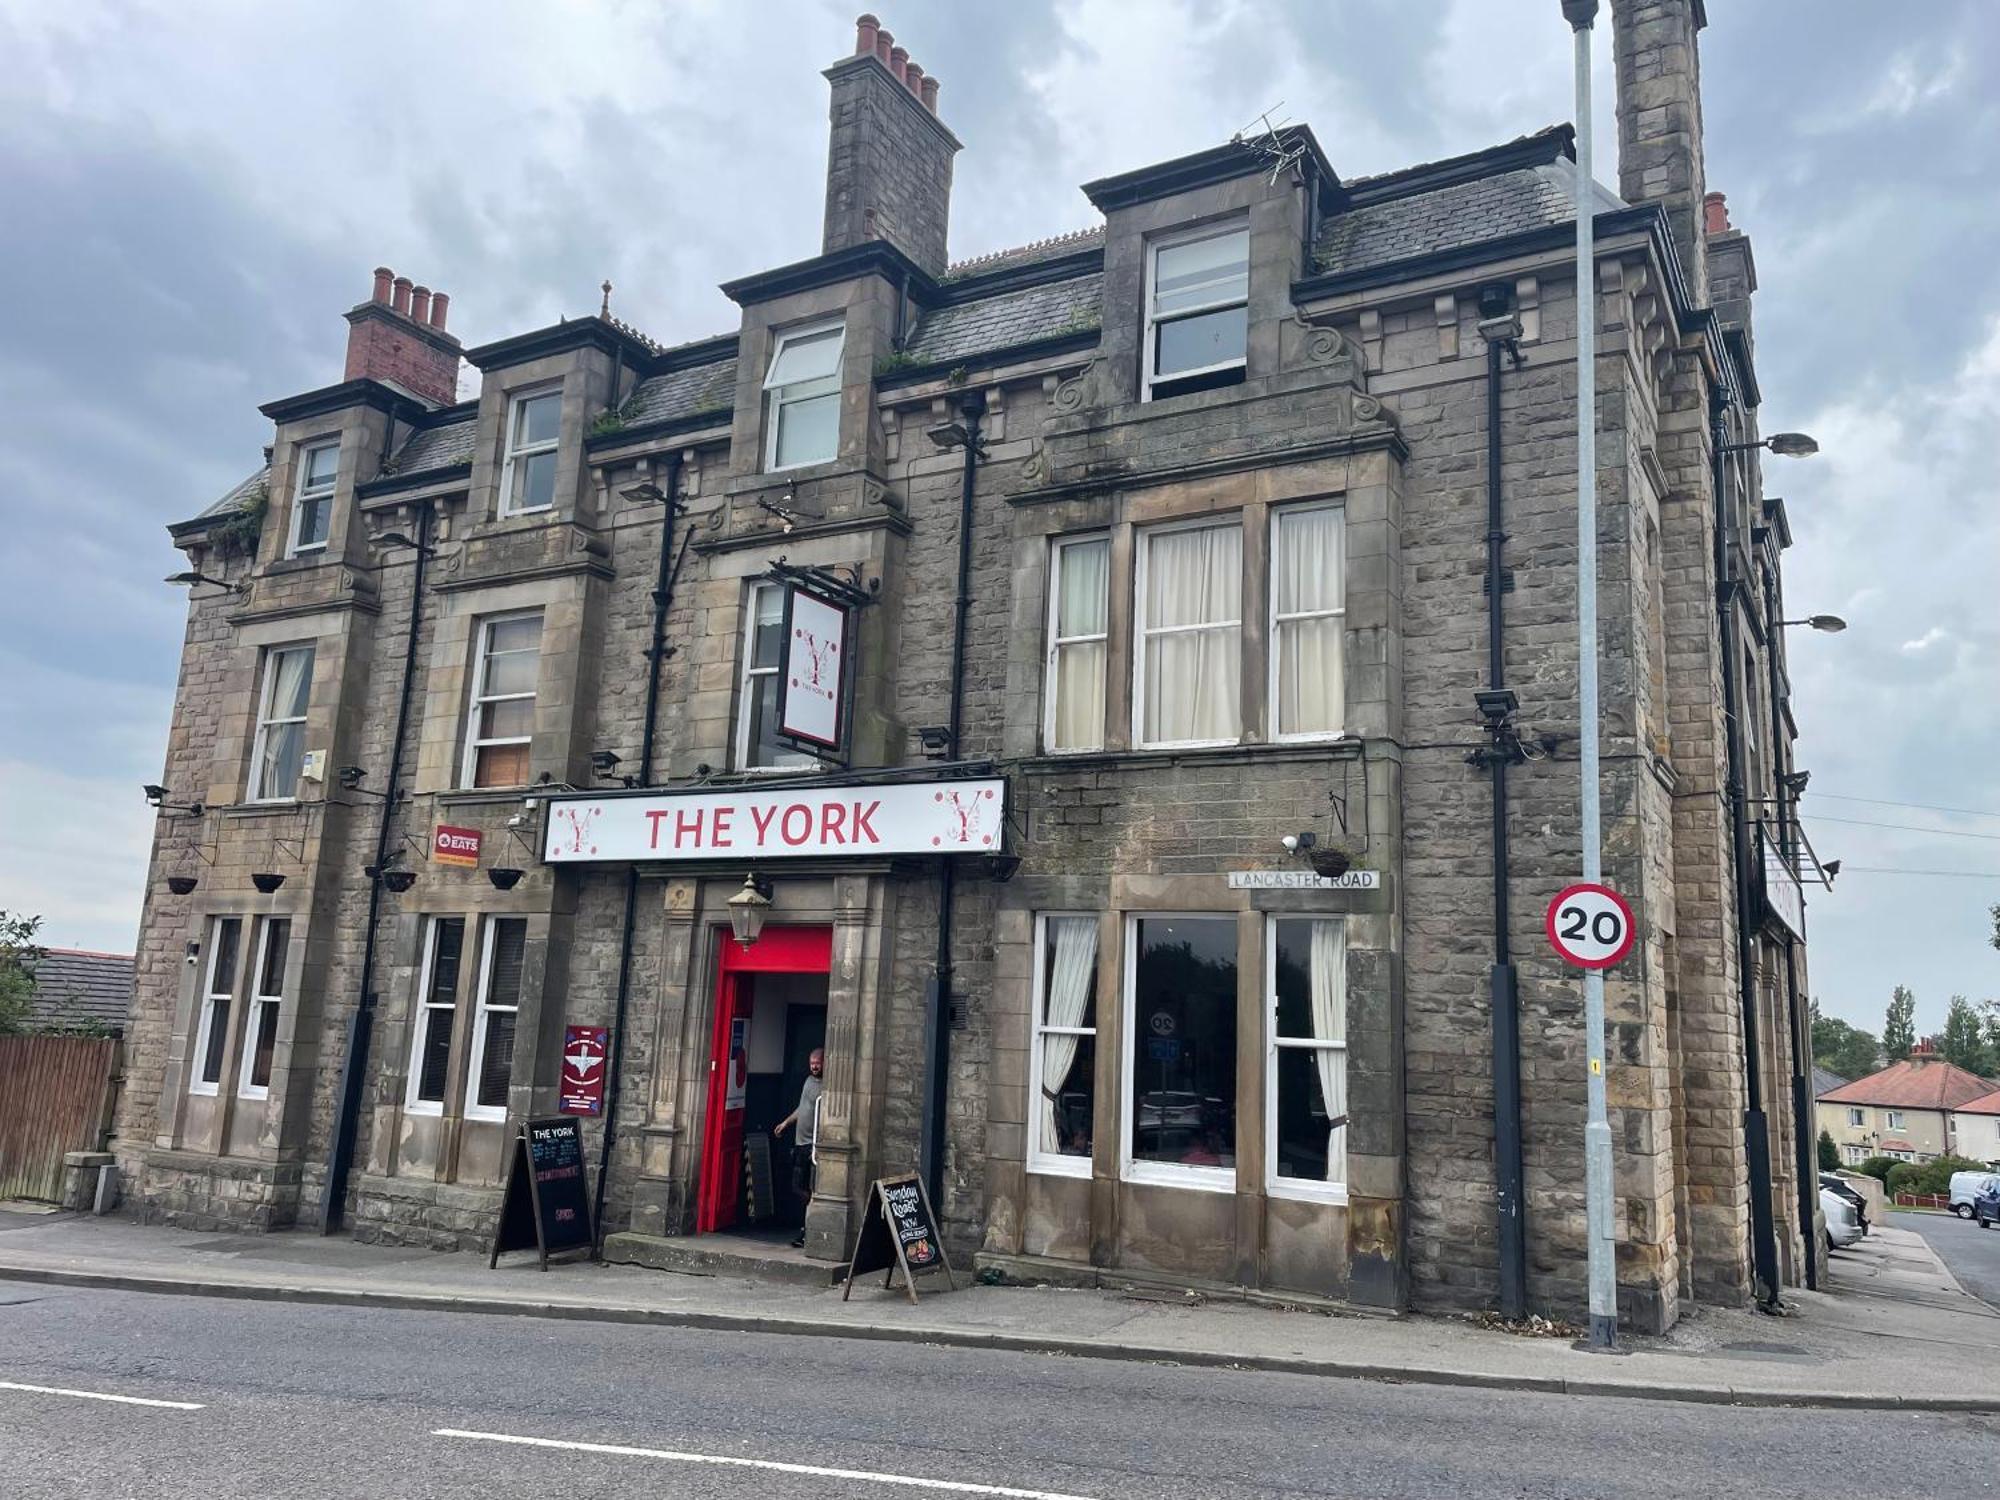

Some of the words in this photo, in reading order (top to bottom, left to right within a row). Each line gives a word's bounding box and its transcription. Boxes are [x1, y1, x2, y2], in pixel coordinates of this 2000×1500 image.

[645, 807, 735, 849] THE
[750, 801, 881, 846] YORK
[451, 840, 478, 851] EATS
[1234, 873, 1322, 888] LANCASTER
[1330, 873, 1373, 888] ROAD
[1560, 906, 1621, 945] 20
[533, 1129, 551, 1139] THE
[552, 1127, 574, 1137] YORK
[885, 1185, 918, 1203] Sunday
